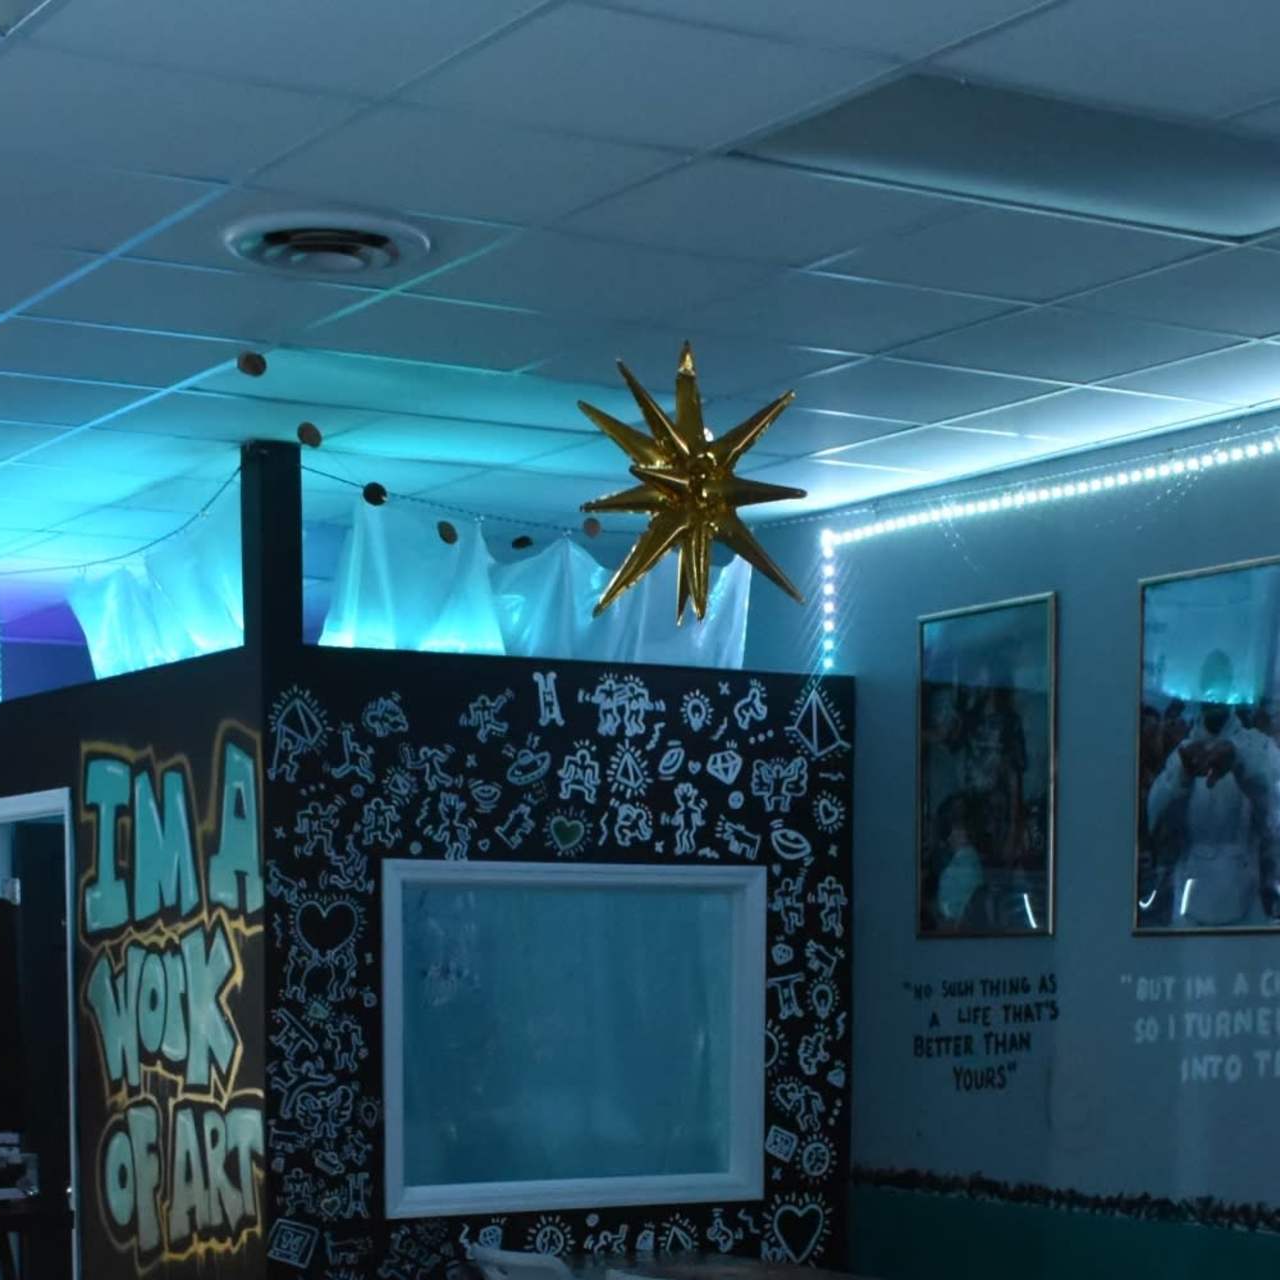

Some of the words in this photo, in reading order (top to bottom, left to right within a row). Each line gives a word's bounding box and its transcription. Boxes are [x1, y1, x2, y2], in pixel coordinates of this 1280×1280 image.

[208, 741, 263, 913] A
[980, 976, 1031, 998] THING
[1039, 973, 1058, 994] AS
[1120, 973, 1175, 1001] "BUT
[1184, 975, 1216, 1000] IM
[1233, 973, 1249, 996] A
[929, 1011, 940, 1028] A
[957, 1005, 991, 1026] LIFE
[1135, 1016, 1158, 1043] SO
[913, 1034, 974, 1058] BETTER
[984, 1030, 1032, 1056] THAN
[953, 1060, 1017, 1091] YOURS"
[1181, 1053, 1242, 1083] INTO
[105, 1105, 160, 1252] OF
[170, 1106, 264, 1244] ART
